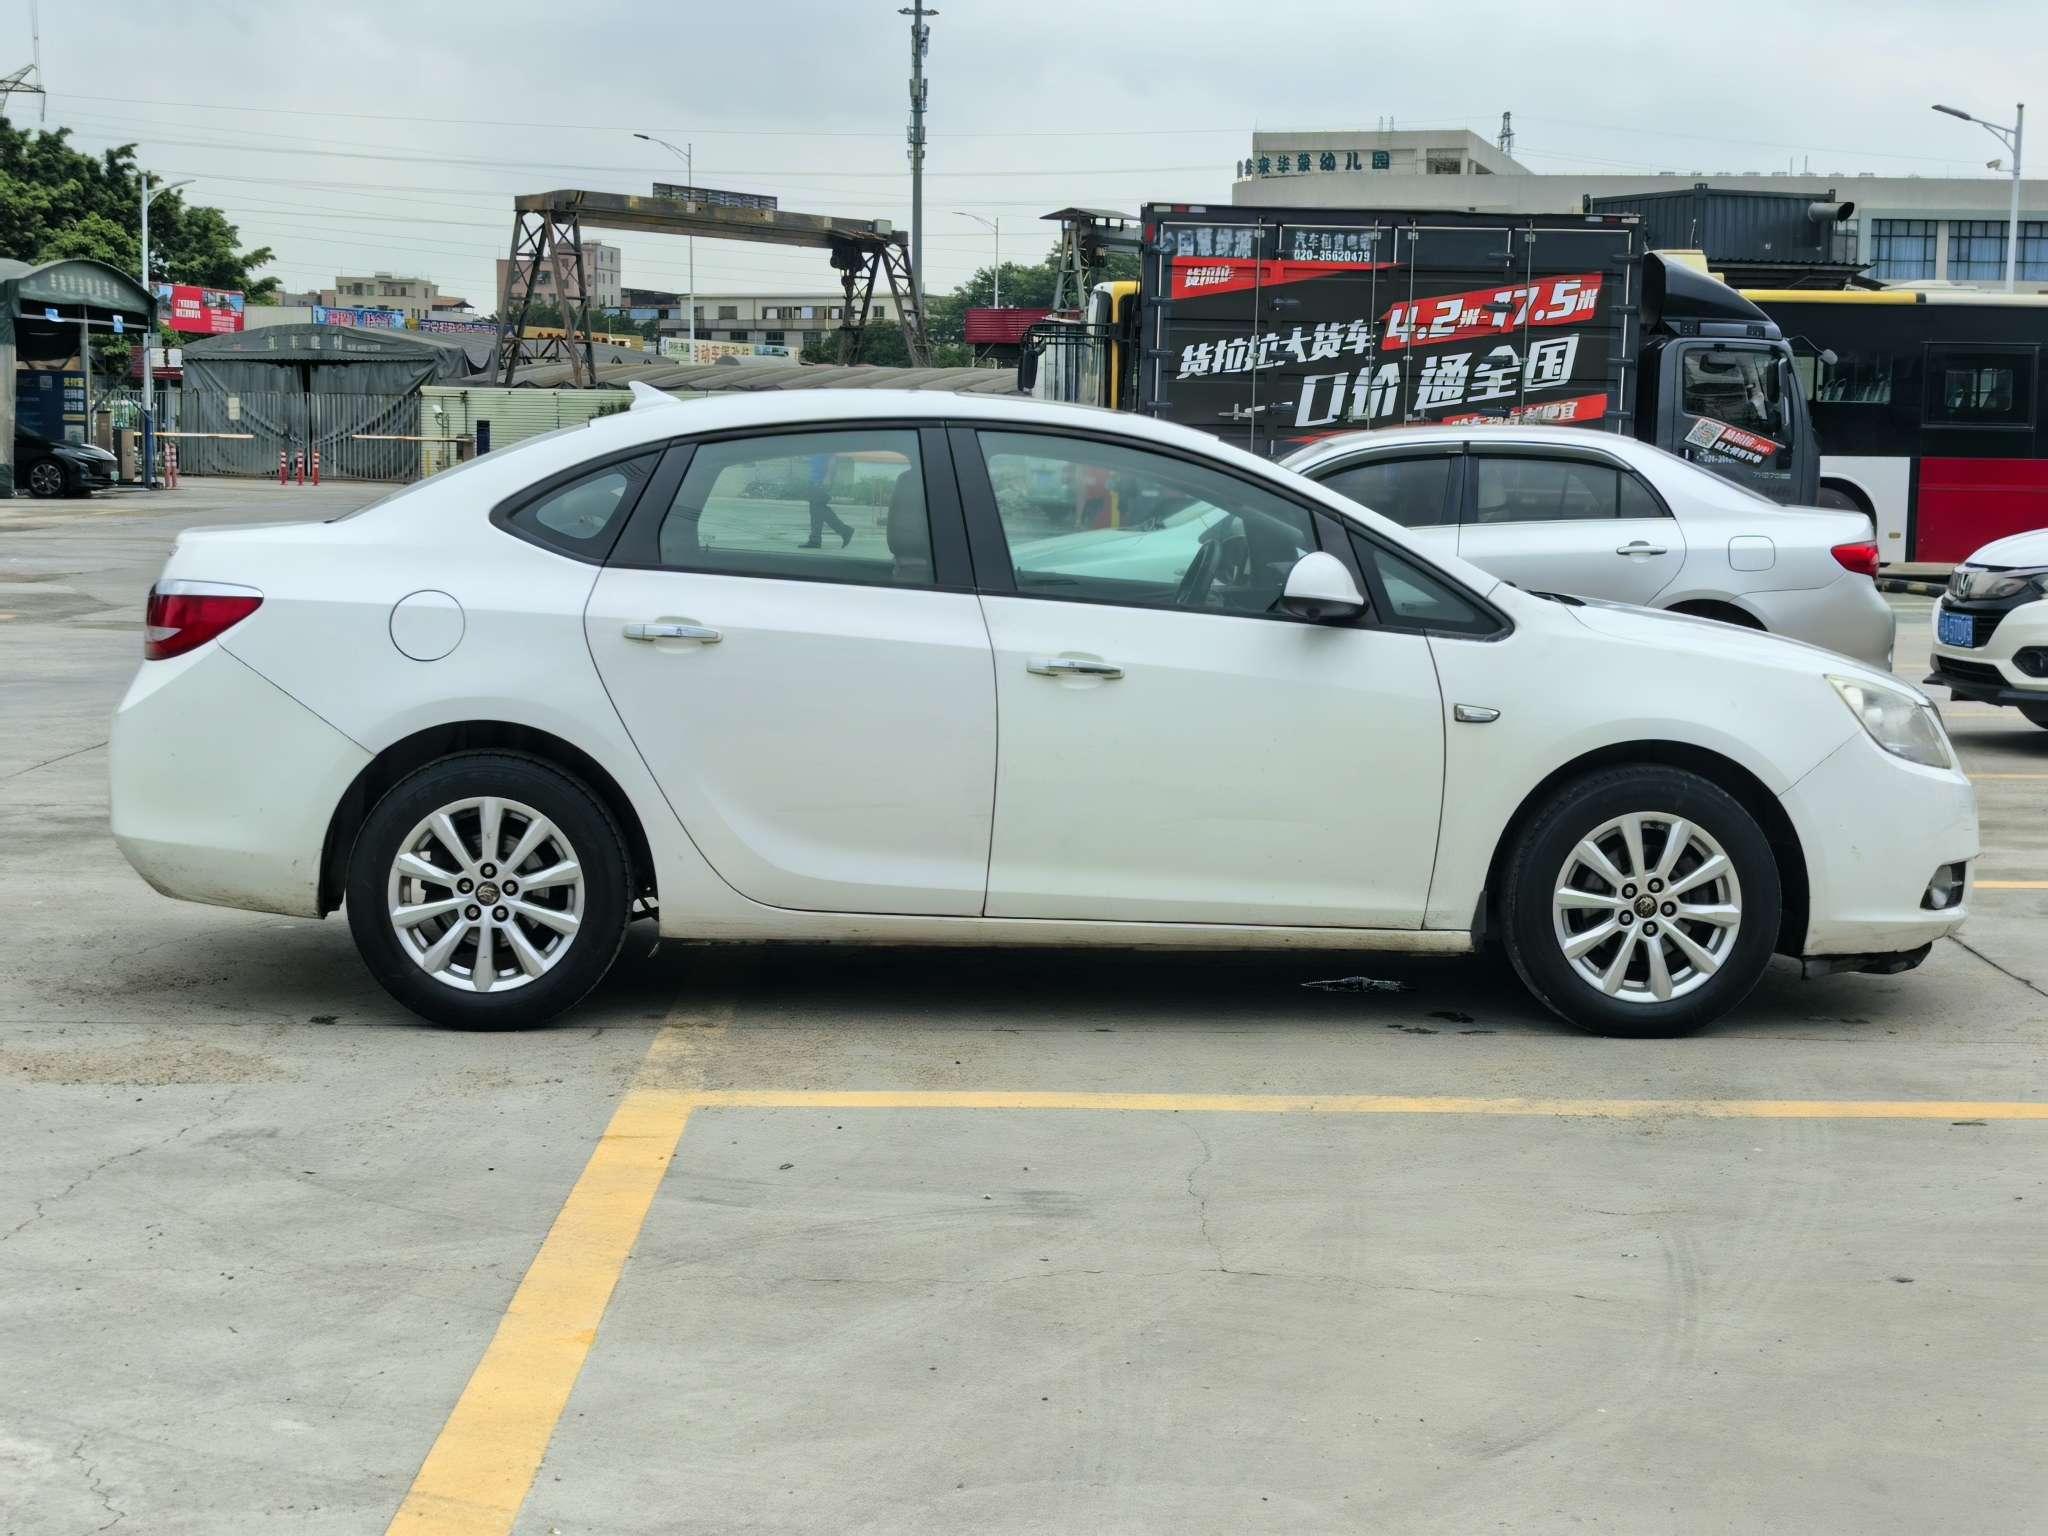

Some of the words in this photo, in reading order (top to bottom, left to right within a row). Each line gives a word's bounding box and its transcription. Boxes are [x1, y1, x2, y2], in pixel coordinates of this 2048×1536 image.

[1175, 318, 1377, 379] 货拉拉大货车
